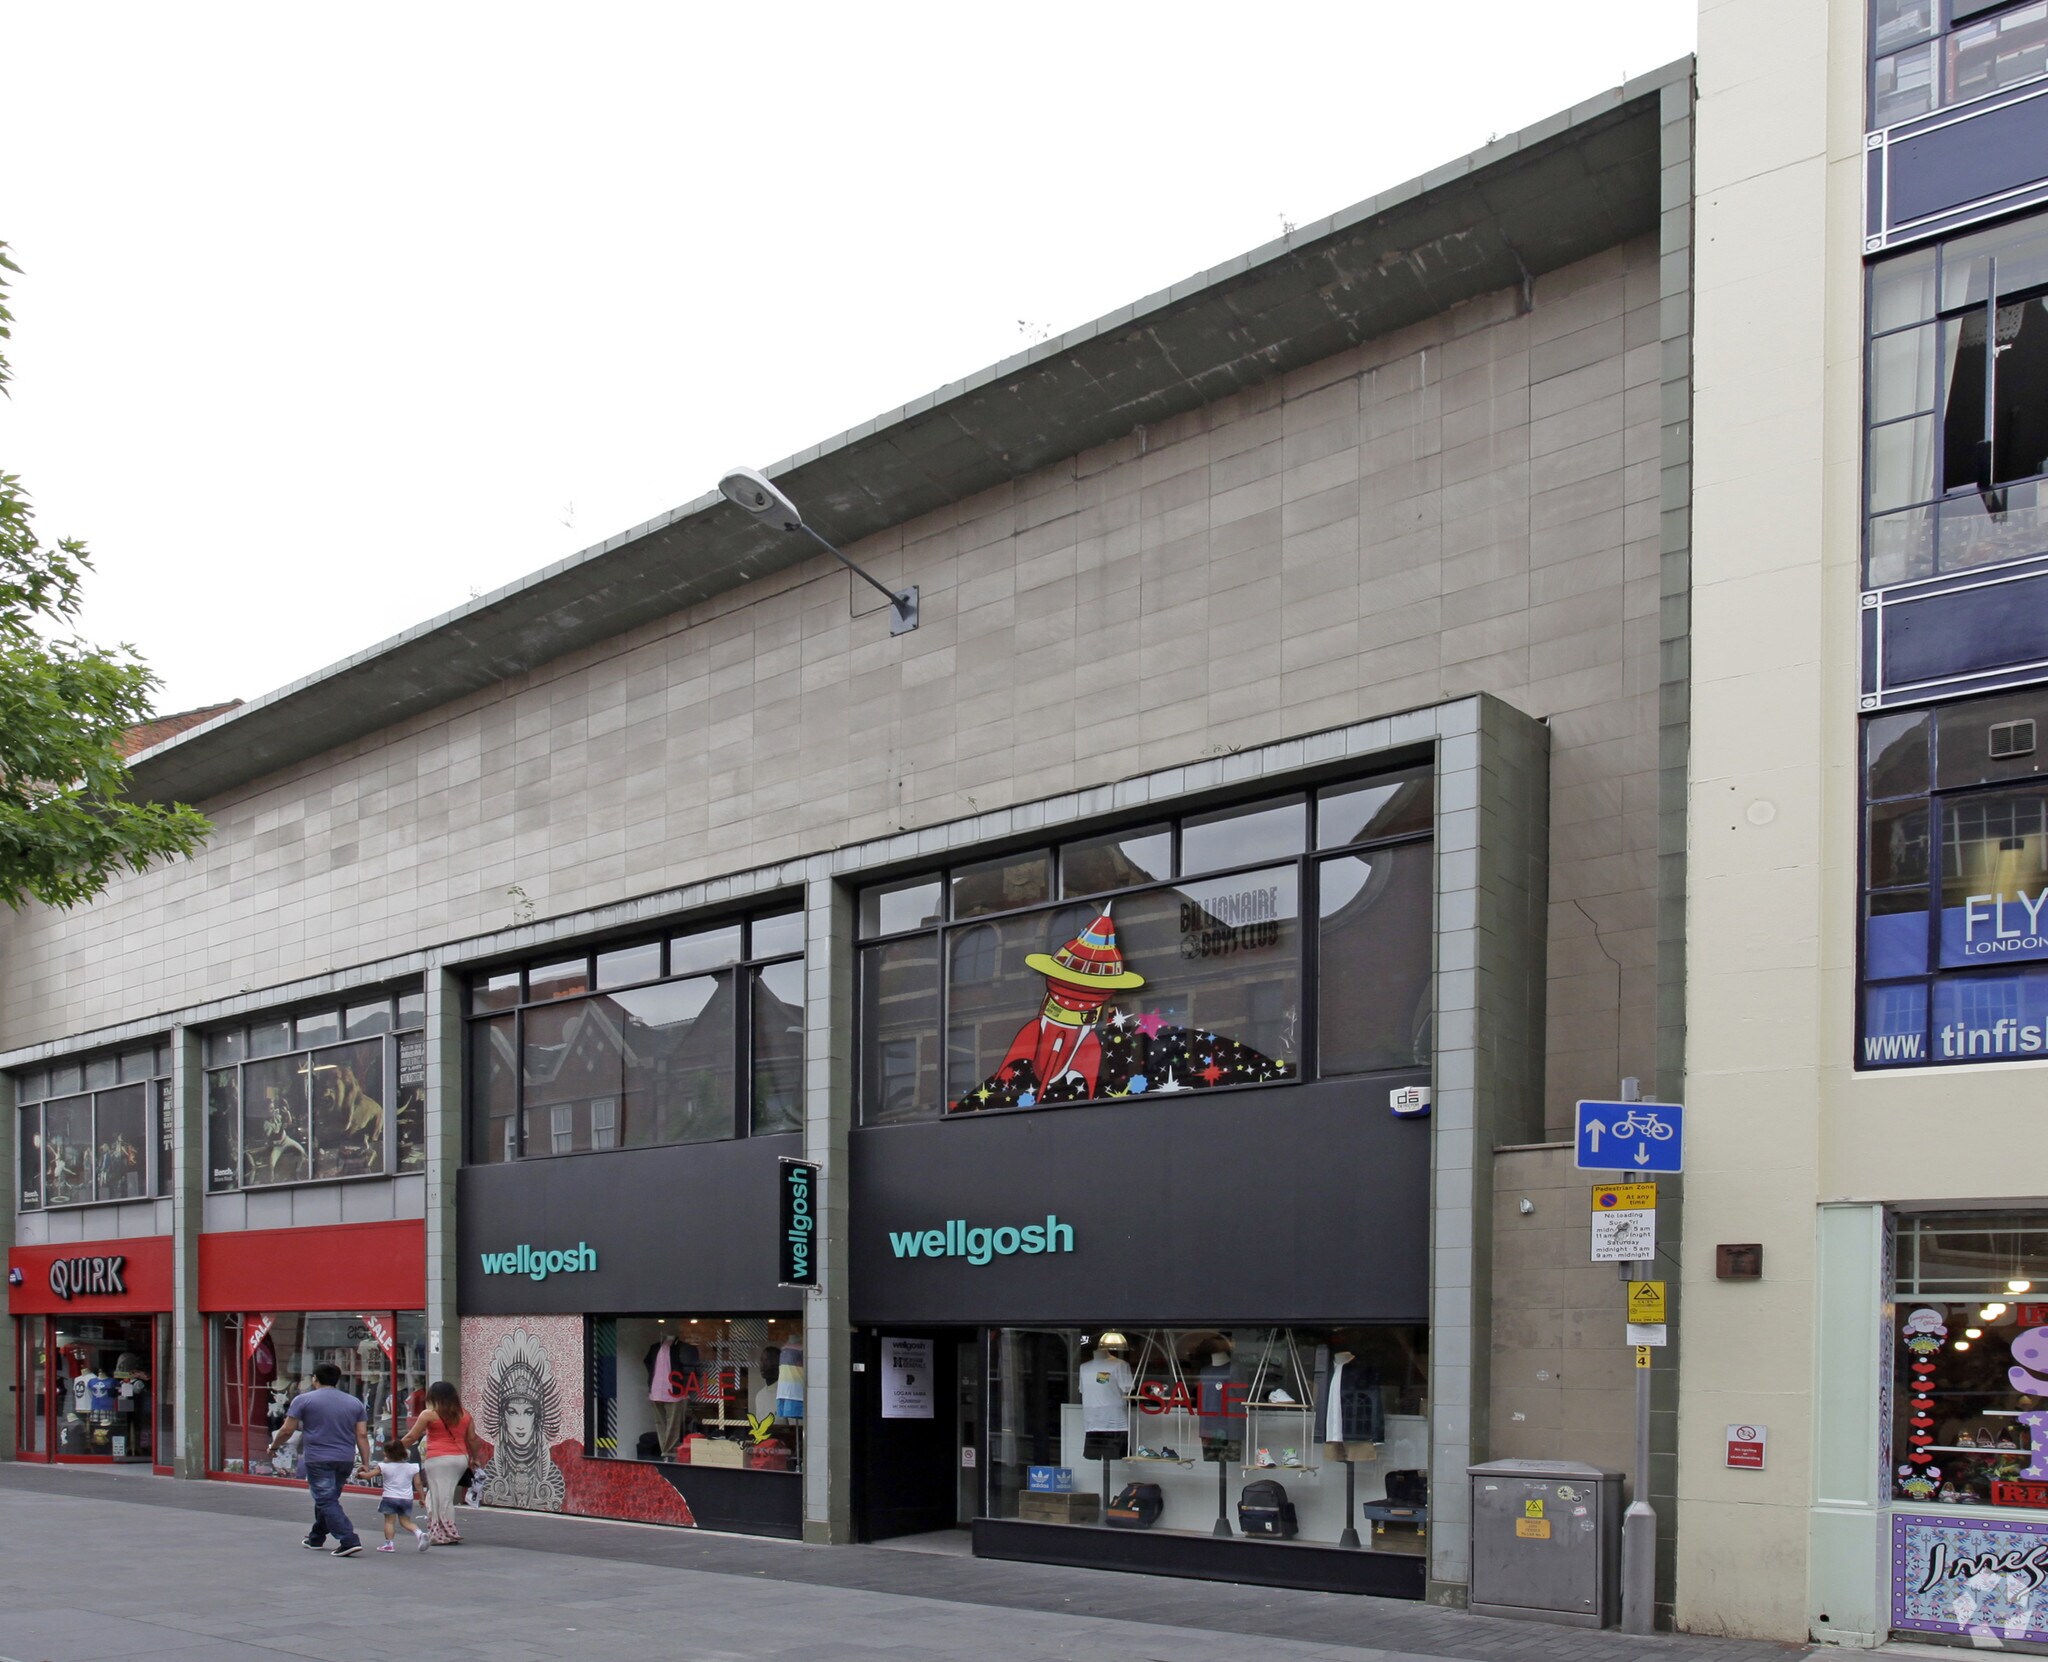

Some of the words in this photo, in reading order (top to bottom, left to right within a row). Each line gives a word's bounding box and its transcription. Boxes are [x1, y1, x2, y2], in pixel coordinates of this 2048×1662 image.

[1180, 886, 1278, 934] BILLIONAIRE
[1965, 887, 2048, 942] FLY
[1201, 927, 1238, 957] BOYS
[1241, 920, 1279, 950] CLUB
[1965, 936, 2048, 956] LONDON
[1864, 1034, 1925, 1061] www.
[788, 1168, 813, 1278] wellgosh
[889, 1215, 1075, 1266] wellgosh
[49, 1256, 125, 1299] QUIRK
[481, 1241, 597, 1281] wellgosh
[249, 1316, 273, 1349] SALE
[368, 1315, 393, 1351] SALE
[892, 1340, 926, 1352] wellgosh
[1637, 1356, 1646, 1366] 4
[667, 1371, 736, 1400] SALE
[1139, 1380, 1248, 1418] SALE
[1918, 1542, 2048, 1602] Irreg
